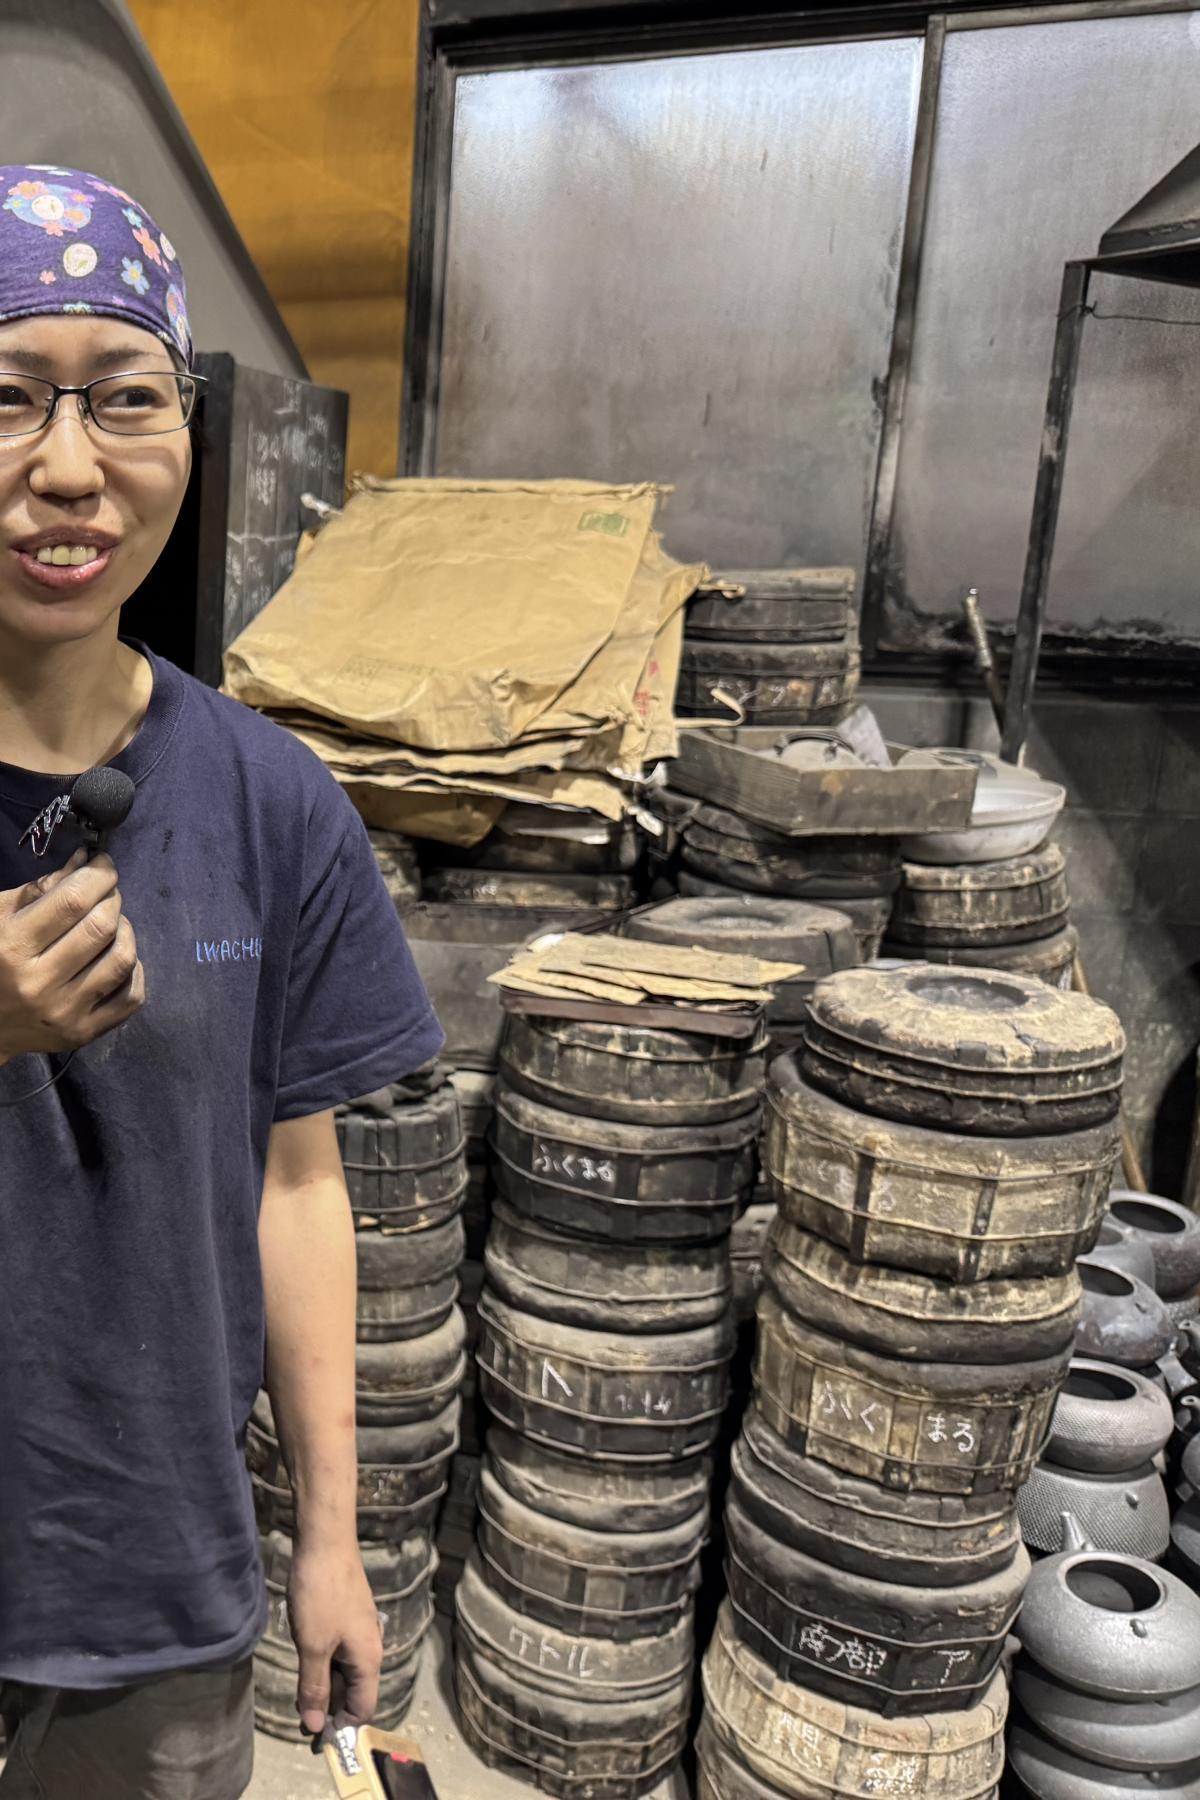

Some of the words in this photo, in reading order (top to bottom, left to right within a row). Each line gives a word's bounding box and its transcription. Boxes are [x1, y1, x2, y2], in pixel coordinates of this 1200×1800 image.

[535, 1143, 616, 1183] ふくまる
[508, 1623, 595, 1678] ケトル
